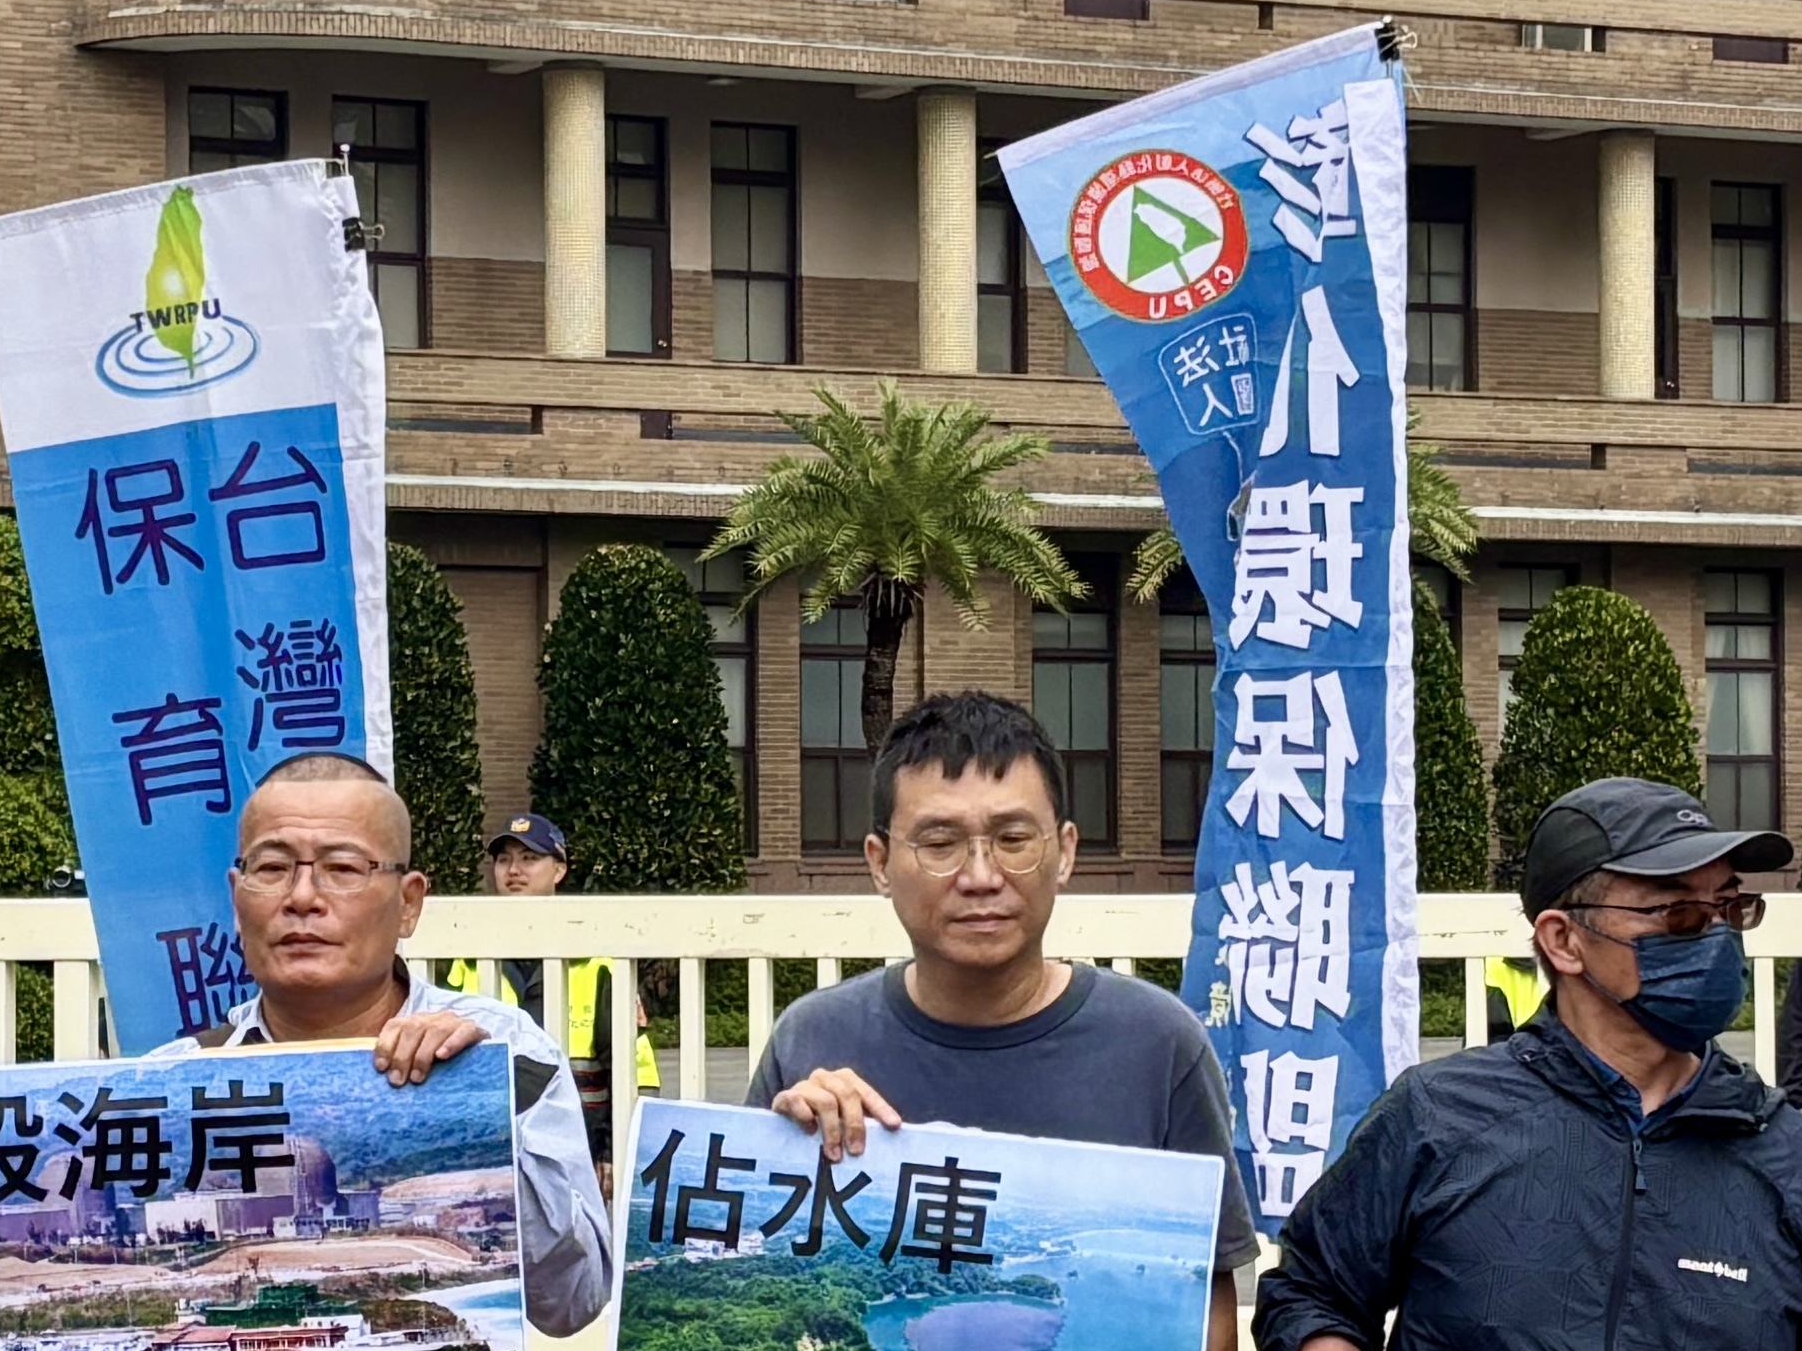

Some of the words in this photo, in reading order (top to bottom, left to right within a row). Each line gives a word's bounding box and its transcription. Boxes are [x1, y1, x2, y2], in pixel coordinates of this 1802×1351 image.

[129, 298, 221, 333] TWRPU
[207, 439, 347, 751] 台灣
[639, 1128, 1003, 1274] 佔水庫
